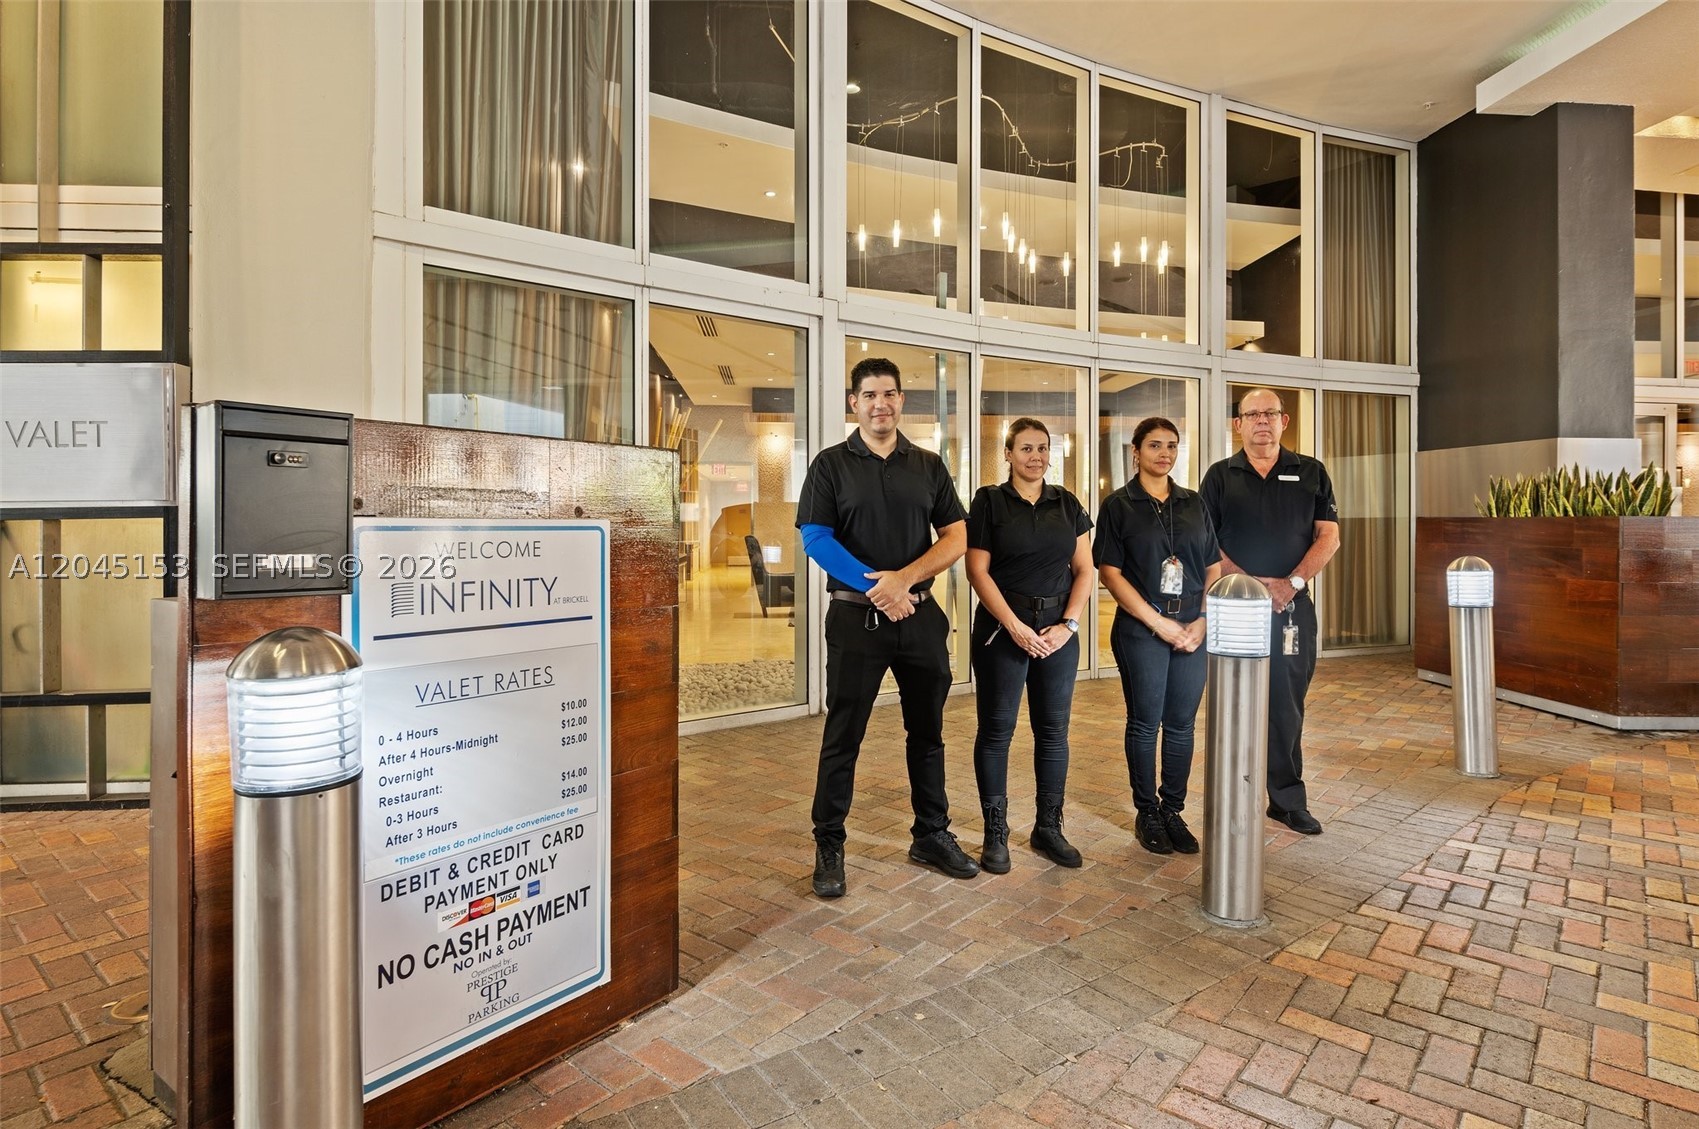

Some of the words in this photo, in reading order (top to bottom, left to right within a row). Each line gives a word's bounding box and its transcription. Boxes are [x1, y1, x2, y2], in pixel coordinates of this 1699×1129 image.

[4, 420, 109, 448] VALET
[435, 540, 541, 560] WELCOME
[420, 577, 558, 615] INFINITY
[562, 595, 589, 604] BRICKELL
[415, 675, 483, 704] VALET
[494, 666, 554, 691] RATES
[561, 699, 587, 712] $10.00
[379, 735, 384, 746] 0
[396, 732, 402, 742] 4
[406, 727, 438, 740] Hours
[561, 716, 587, 729] $12.00
[379, 752, 406, 767] After
[410, 749, 416, 760] 4
[420, 733, 498, 758] Hours-Midnight
[561, 733, 587, 746] $25.00
[379, 766, 434, 787] Overnight
[561, 767, 587, 781] $14.00
[379, 784, 443, 808] Restaurant:
[561, 784, 587, 799] $25.00
[386, 813, 403, 827] 0-3
[407, 805, 439, 821] Hours
[385, 831, 413, 848] After
[417, 828, 423, 839] 3
[427, 820, 457, 837] Hours
[428, 845, 451, 858] rates
[453, 840, 465, 849] do
[467, 835, 481, 845] not
[483, 824, 513, 841] include
[516, 810, 565, 830] convenience
[566, 806, 579, 816] fee
[380, 868, 441, 902] DEBIT
[448, 863, 460, 880] &
[467, 839, 531, 874] CREDIT
[542, 824, 584, 849] CARD
[424, 870, 509, 913] PAYMENT
[516, 853, 558, 880] ONLY
[442, 908, 467, 921] DISCOVER
[500, 892, 517, 903] VISA
[377, 954, 415, 989] NO
[424, 924, 489, 969] CASH
[496, 886, 591, 941] PAYMENT
[453, 958, 473, 974] NO
[478, 949, 491, 963] IN
[496, 944, 504, 956] &
[508, 932, 533, 950] OUT
[467, 963, 519, 992] PRESTIGE
[471, 961, 502, 978] Operated
[468, 993, 520, 1024] PARKING
